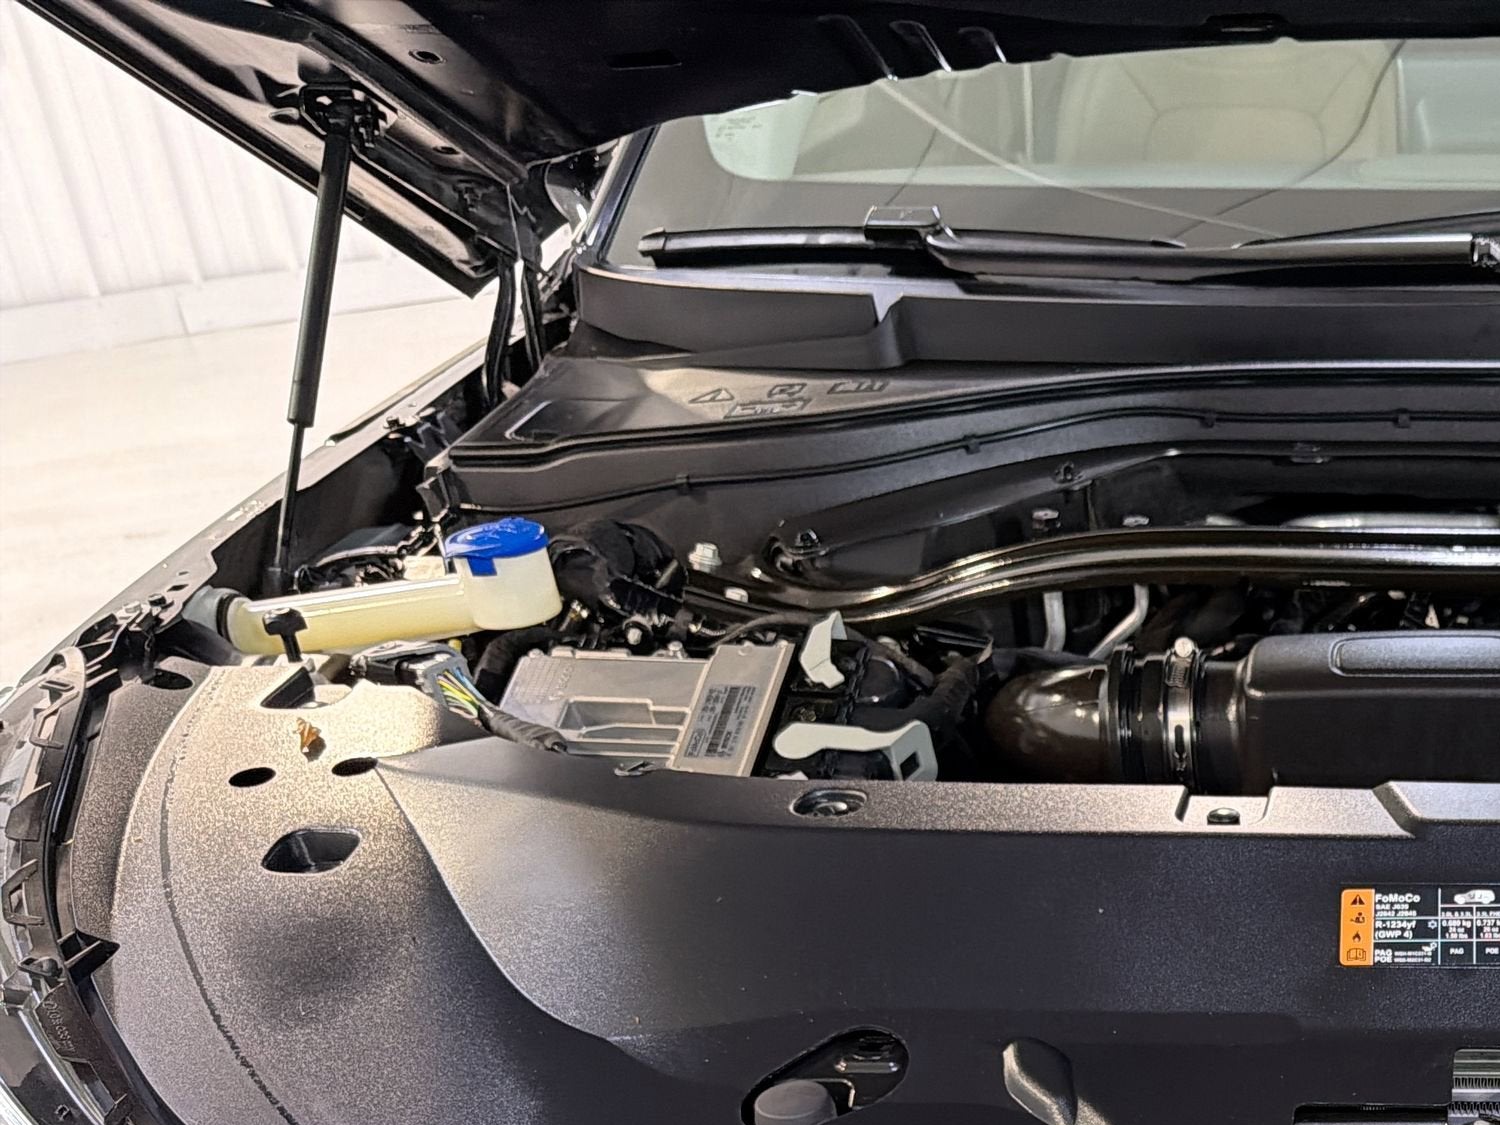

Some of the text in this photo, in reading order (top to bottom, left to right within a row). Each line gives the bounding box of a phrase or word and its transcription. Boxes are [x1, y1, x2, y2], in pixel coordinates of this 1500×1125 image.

[1375, 893, 1421, 903] FoMoCo
[1375, 920, 1417, 930] R-1234yf
[1462, 919, 1472, 928] kg
[1375, 930, 1413, 940] (GWP 4)
